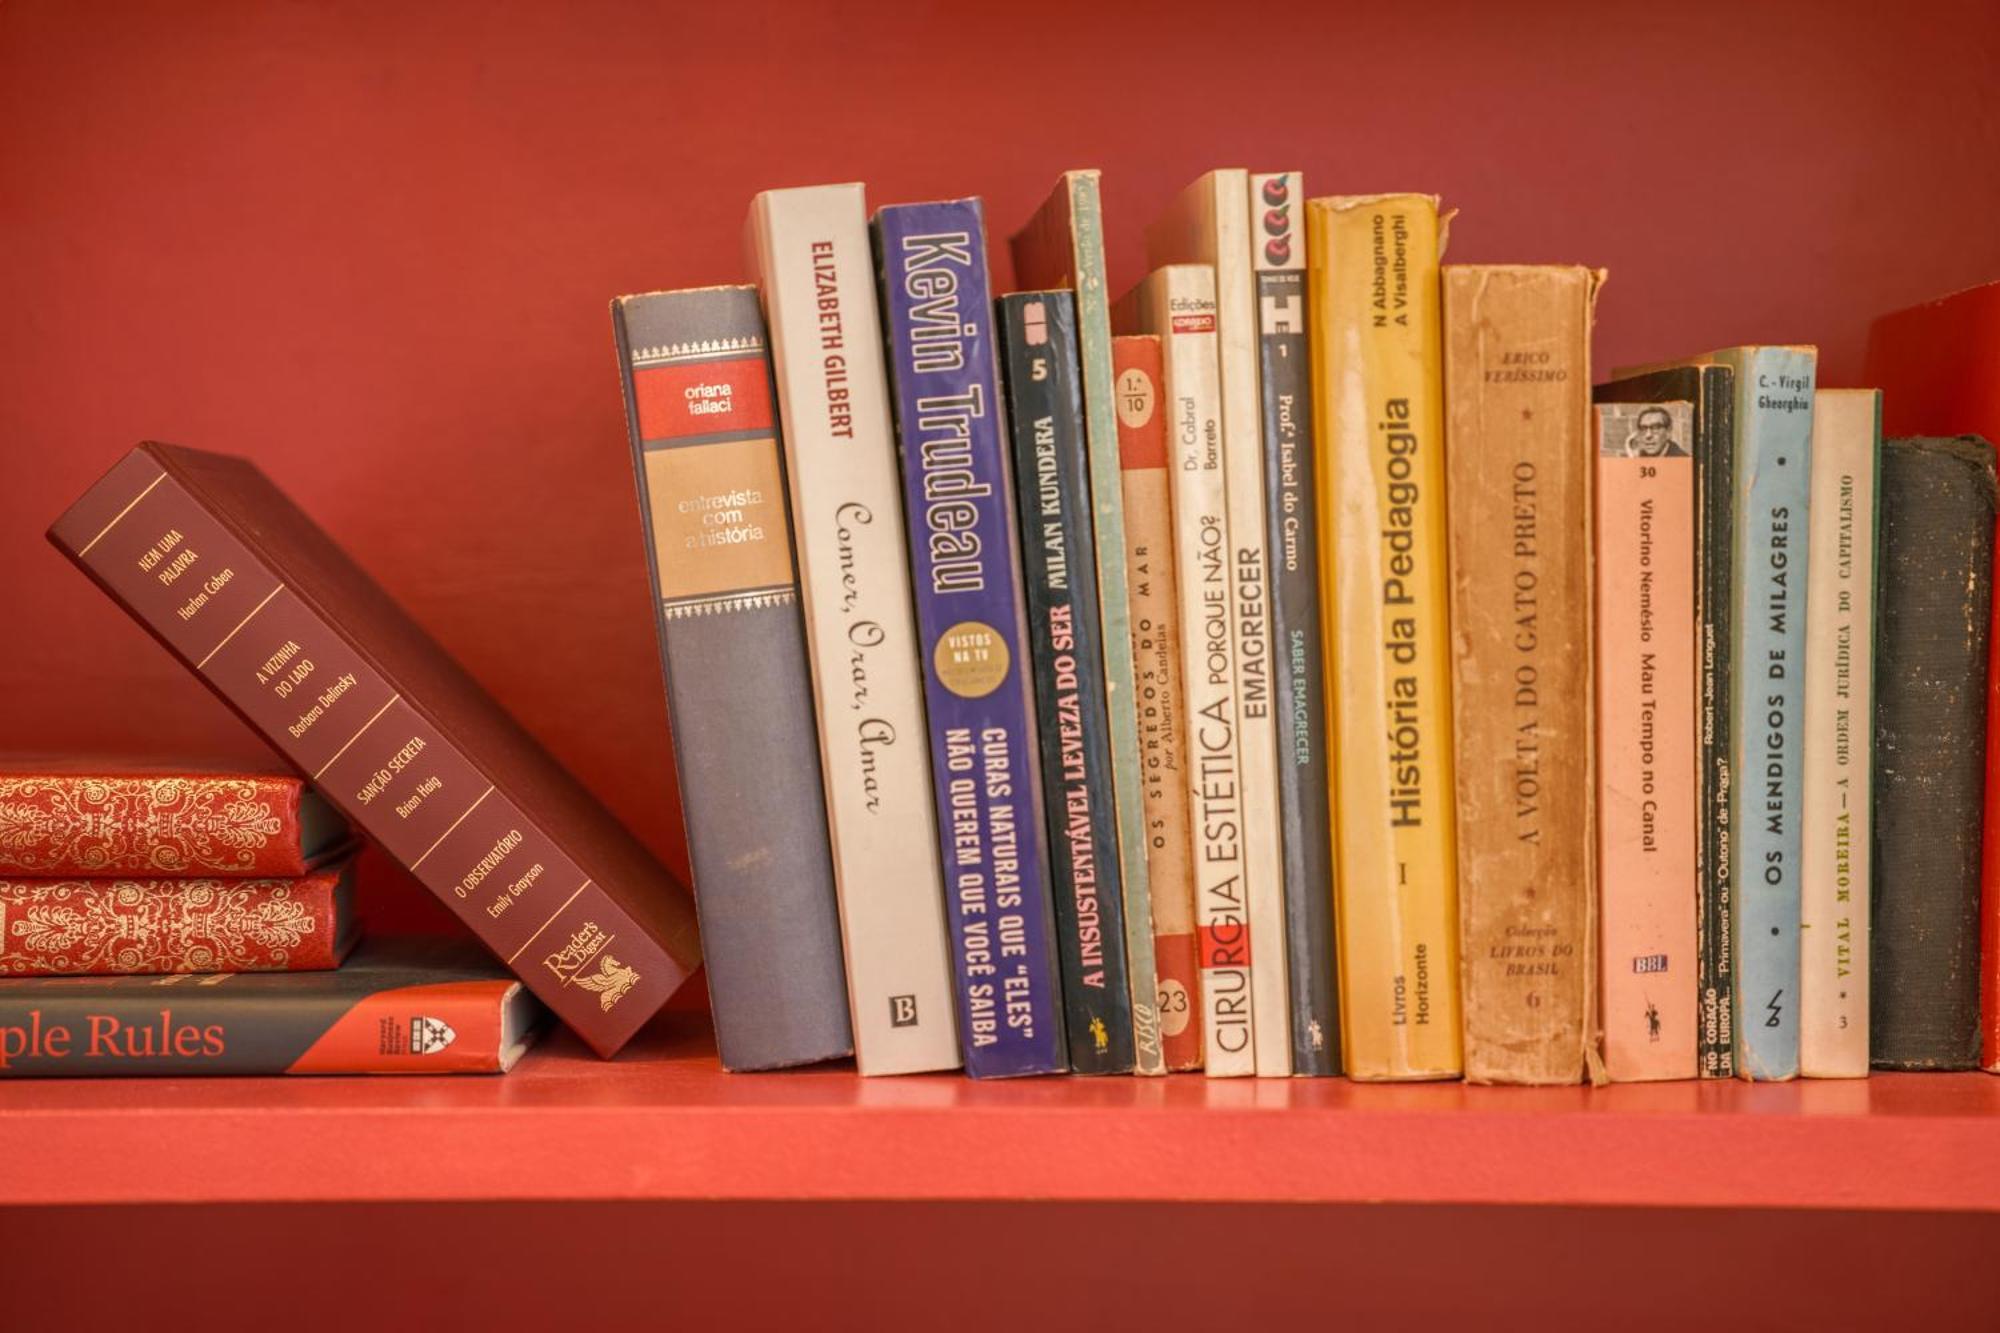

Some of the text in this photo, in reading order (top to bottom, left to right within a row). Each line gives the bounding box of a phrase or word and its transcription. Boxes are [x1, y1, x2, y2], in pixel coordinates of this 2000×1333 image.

[1372, 214, 1388, 327] N Abbagnano
[1393, 215, 1409, 327] A Visalberghi
[902, 231, 977, 374] Kevin
[1170, 298, 1216, 312] Edições
[811, 240, 853, 440] ELIZABETH GILBERT
[1502, 351, 1549, 365] ERICO
[684, 383, 732, 399] oriana
[1031, 359, 1047, 380] 5
[688, 397, 732, 415] fallaci
[1128, 398, 1144, 412] 10
[1180, 396, 1197, 447] Cabral
[1204, 419, 1217, 471] Barreto
[1281, 443, 1299, 490] Isabel
[917, 384, 992, 594] Trudeau
[1639, 466, 1656, 478] 30
[678, 488, 763, 513] entrevista
[703, 509, 743, 526] com
[1034, 415, 1068, 590] MILAN KUNDERA
[1283, 493, 1299, 514] do
[138, 529, 184, 572] NEM UMA
[1283, 519, 1300, 572] Carmo
[1838, 475, 1853, 580] CAPITALISMO
[158, 548, 199, 586] PALAVRA
[1137, 546, 1150, 598] MAR
[177, 568, 235, 620] Harlan Coben
[1379, 398, 1421, 828] História da Pedagogia
[1838, 590, 1850, 613] DO
[835, 501, 897, 815] Comer, Orar, Amar
[948, 633, 992, 649] VISTOS
[953, 648, 989, 663] NA TV
[1139, 618, 1152, 650] DO
[1238, 547, 1268, 719] EMAGRECER
[1513, 461, 1541, 848] A VOLTA DO GATO PRETO
[256, 640, 301, 685] A VIZINHA
[275, 659, 315, 698] DO LADO
[1639, 499, 1657, 854] Vitorino Nemésio Mau Tempo no Canal
[1835, 624, 1850, 699] JURÍDICA
[288, 673, 357, 738] Barbara Delinsky
[1156, 623, 1178, 771] por Alberto Candeias
[1290, 629, 1310, 765] SABER EMAGRECER
[1766, 506, 1789, 886] OS MENDIGOS DE MILAGRES
[1143, 670, 1163, 800] SEGREDOS
[1837, 709, 1849, 766] ORDEM
[356, 736, 427, 806] SANÇÃO SECRETA
[1050, 604, 1106, 989] A INSUSTENTÁVEL LEVEZA DO SER
[1193, 515, 1248, 1054] CIRURGIA ESTÉTICA PORQUE NÃO?
[395, 776, 443, 819] Brian Haig
[1717, 807, 1729, 824] de
[1152, 819, 1166, 850] OS
[1836, 813, 1851, 902] MOREIRA
[454, 829, 523, 898] O OBSERVATÓRIO
[946, 728, 998, 1047] NÃO QUEREM QUE VOCÊ SAIBA
[981, 727, 1034, 1039] CURAS NATURAIS QUE “ELES”
[486, 863, 545, 919] Emily Grayson
[1720, 887, 1729, 903] ou
[544, 921, 599, 982] Reader's
[574, 931, 608, 964] Digest
[1490, 944, 1574, 958] LIVROS DO
[1505, 962, 1559, 976] BRASIL
[1837, 918, 1850, 979] VITAL
[894, 997, 916, 1023] B
[1158, 990, 1187, 1013] 23
[1393, 975, 1408, 1025] Livros
[1415, 943, 1428, 1025] Horizonte
[84, 1008, 225, 1057] Rules
[1704, 988, 1719, 1070] NO CORAÇÃO
[1720, 1051, 1731, 1069] DA
